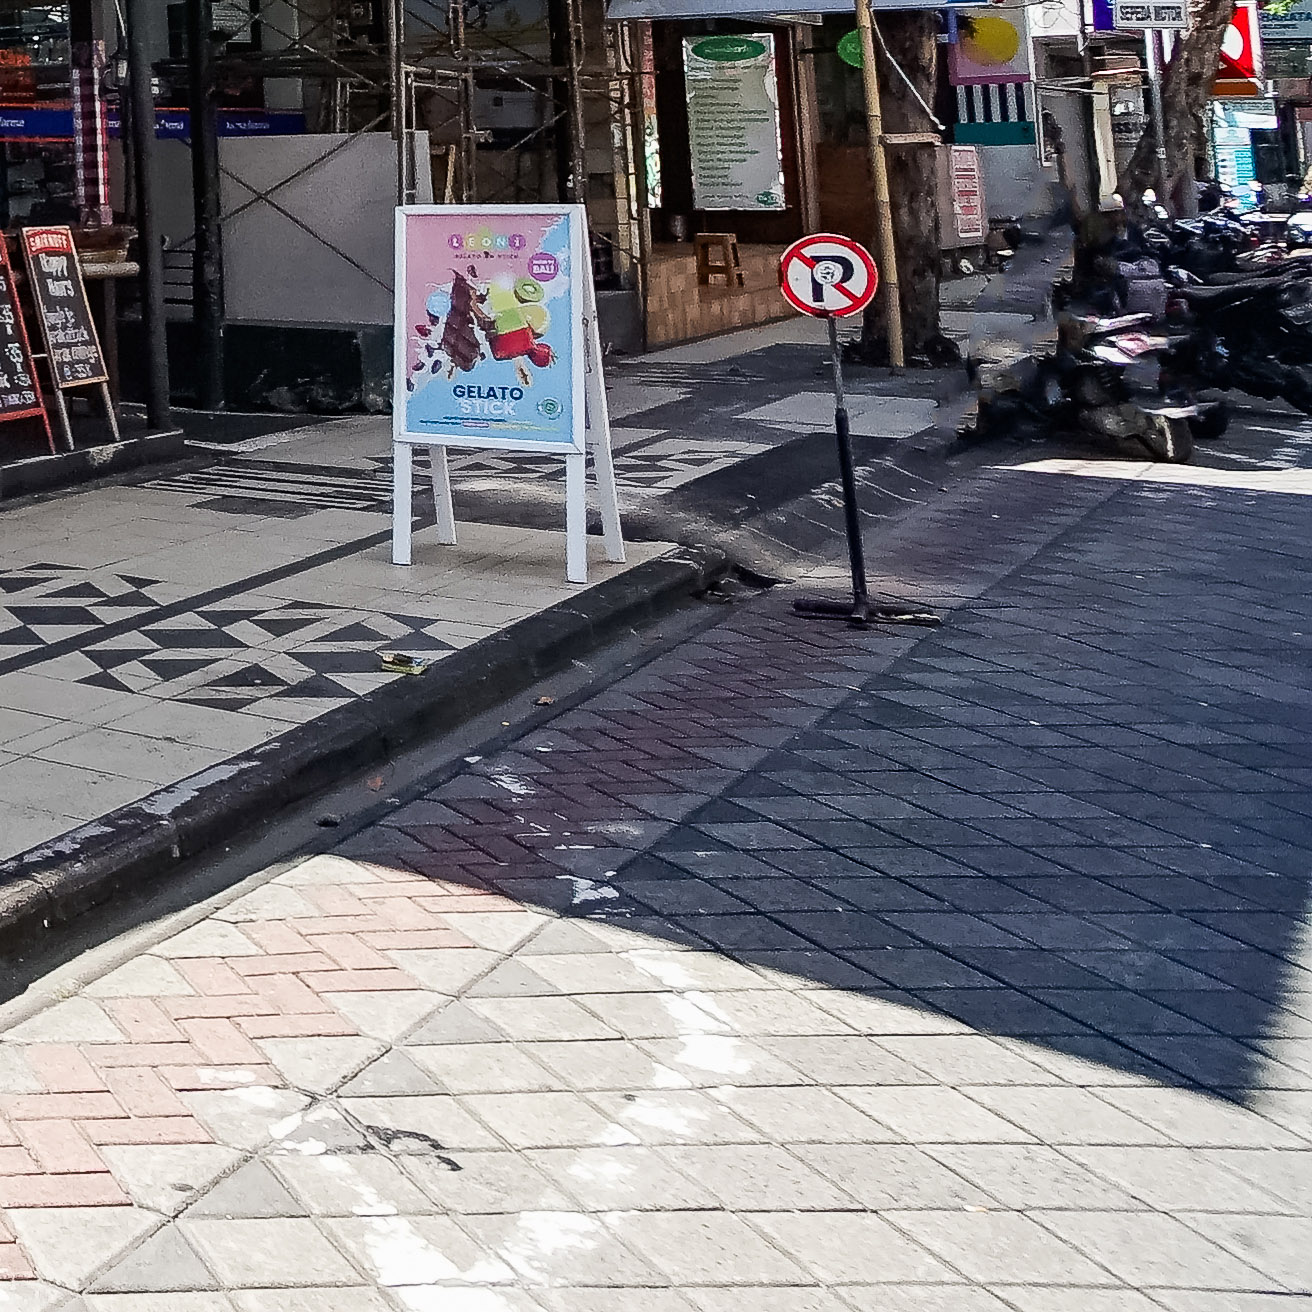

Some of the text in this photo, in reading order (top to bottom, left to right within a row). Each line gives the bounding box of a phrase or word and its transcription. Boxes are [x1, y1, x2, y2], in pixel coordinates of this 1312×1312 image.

[810, 255, 854, 302] P
[453, 384, 524, 401] GELATO
[460, 400, 516, 415] STICK
